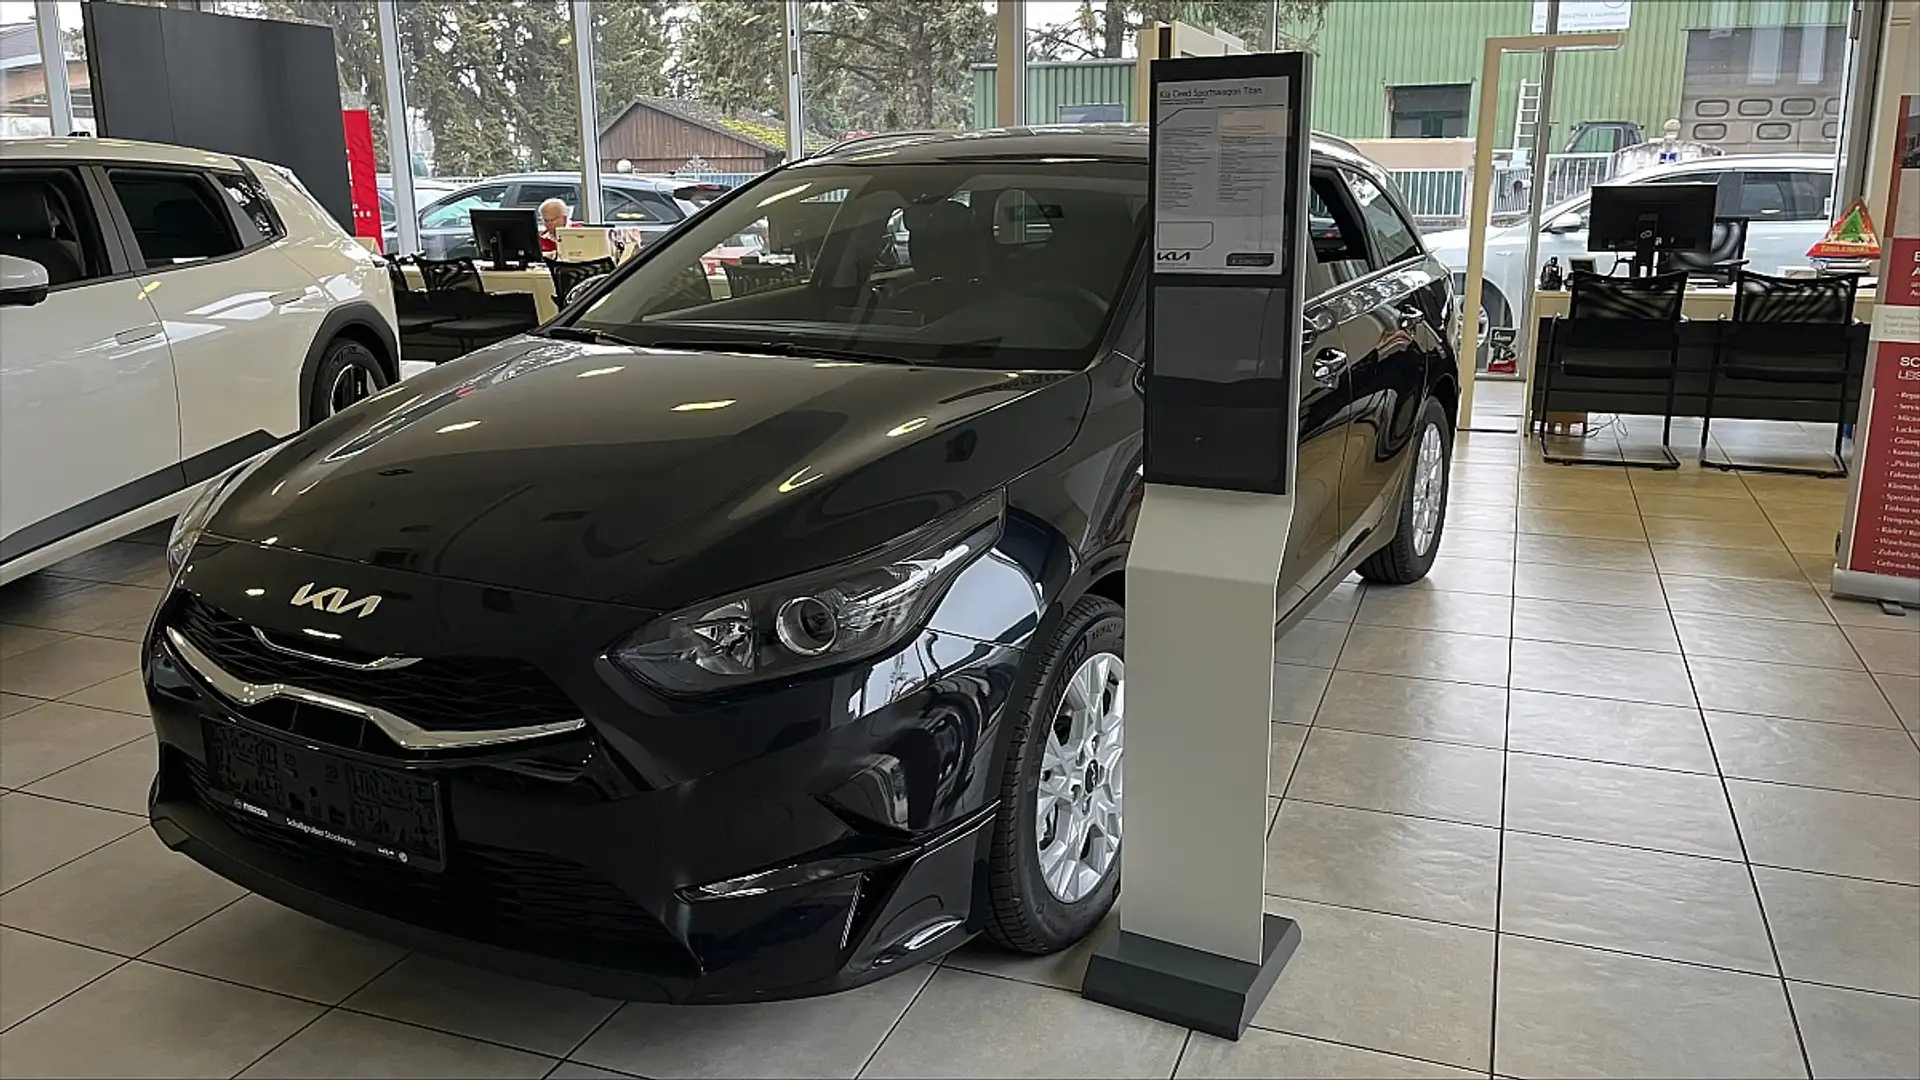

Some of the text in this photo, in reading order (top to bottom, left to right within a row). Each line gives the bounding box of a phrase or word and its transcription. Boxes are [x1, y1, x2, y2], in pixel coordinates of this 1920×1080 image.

[1173, 90, 1191, 98] Ceed
[1193, 88, 1241, 98] Sportswagon
[1157, 251, 1190, 261] KIA
[290, 582, 382, 618] KIA
